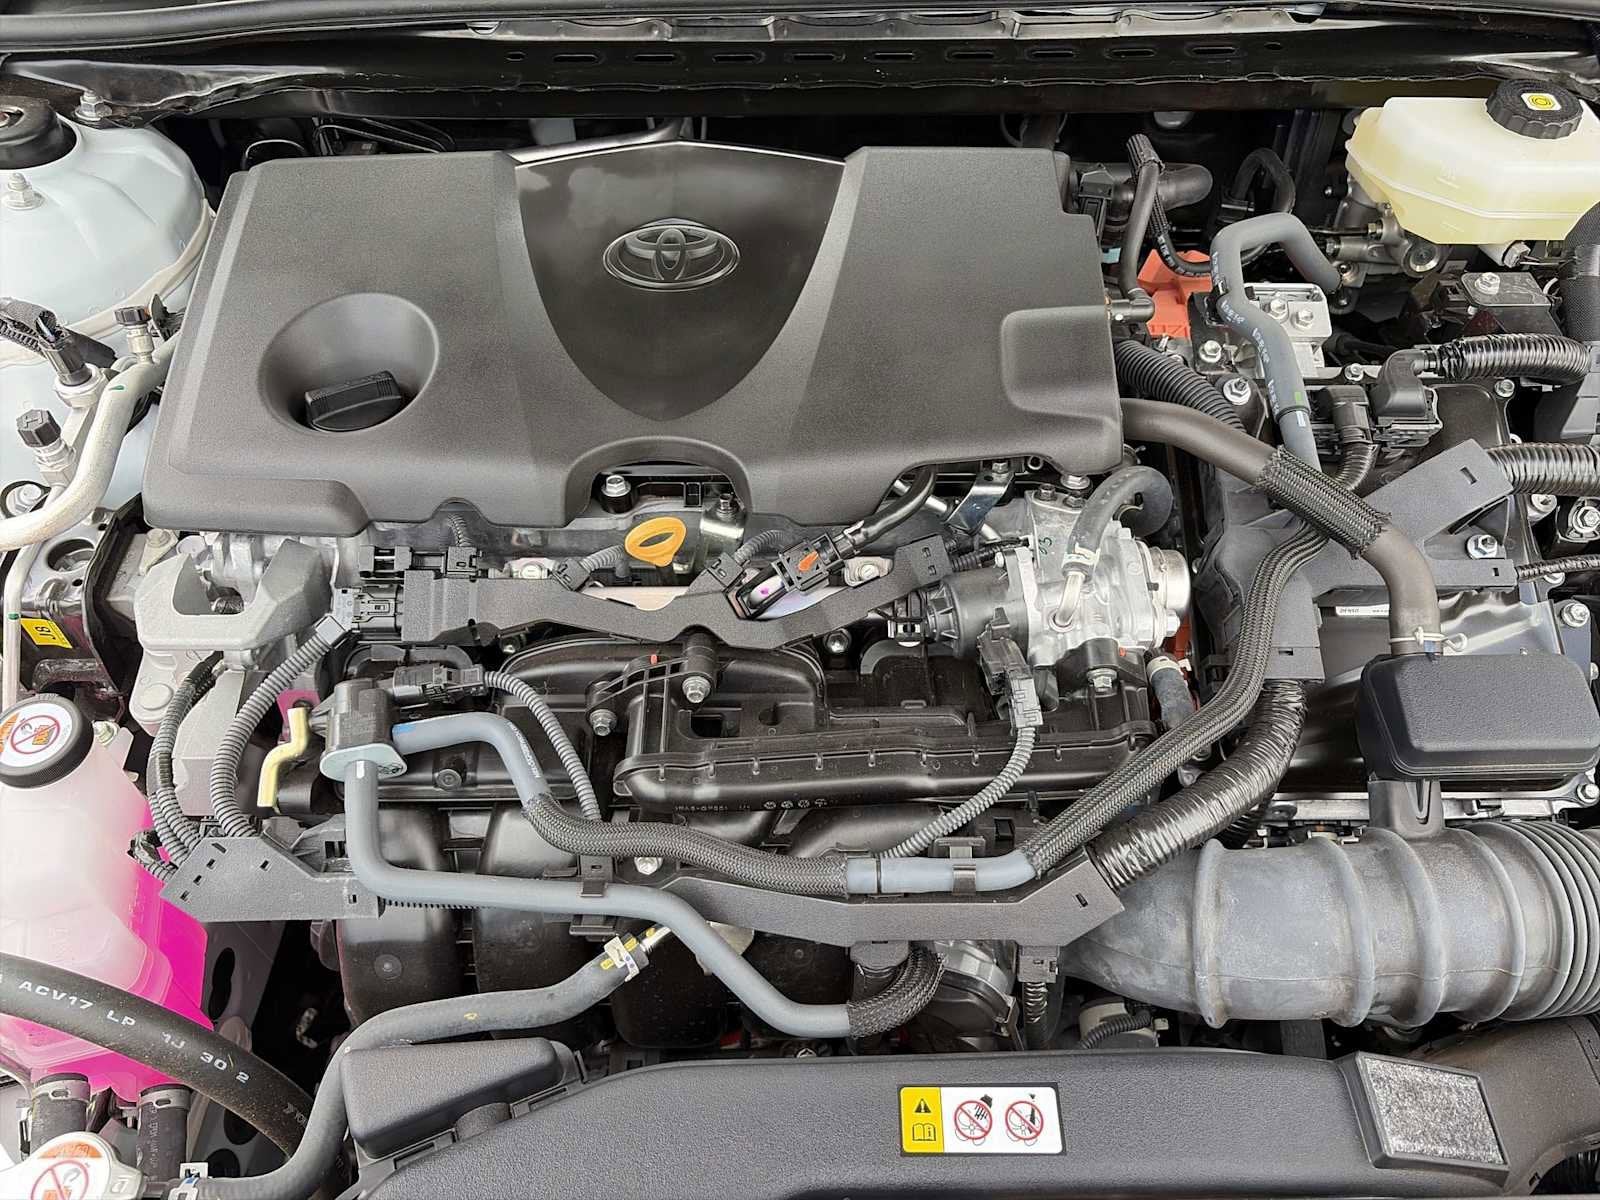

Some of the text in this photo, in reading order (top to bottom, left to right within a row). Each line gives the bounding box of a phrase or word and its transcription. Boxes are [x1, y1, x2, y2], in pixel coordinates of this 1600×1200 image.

[34, 626, 56, 640] J8
[18, 980, 250, 1083] ACV17 LP 1J 30 2
